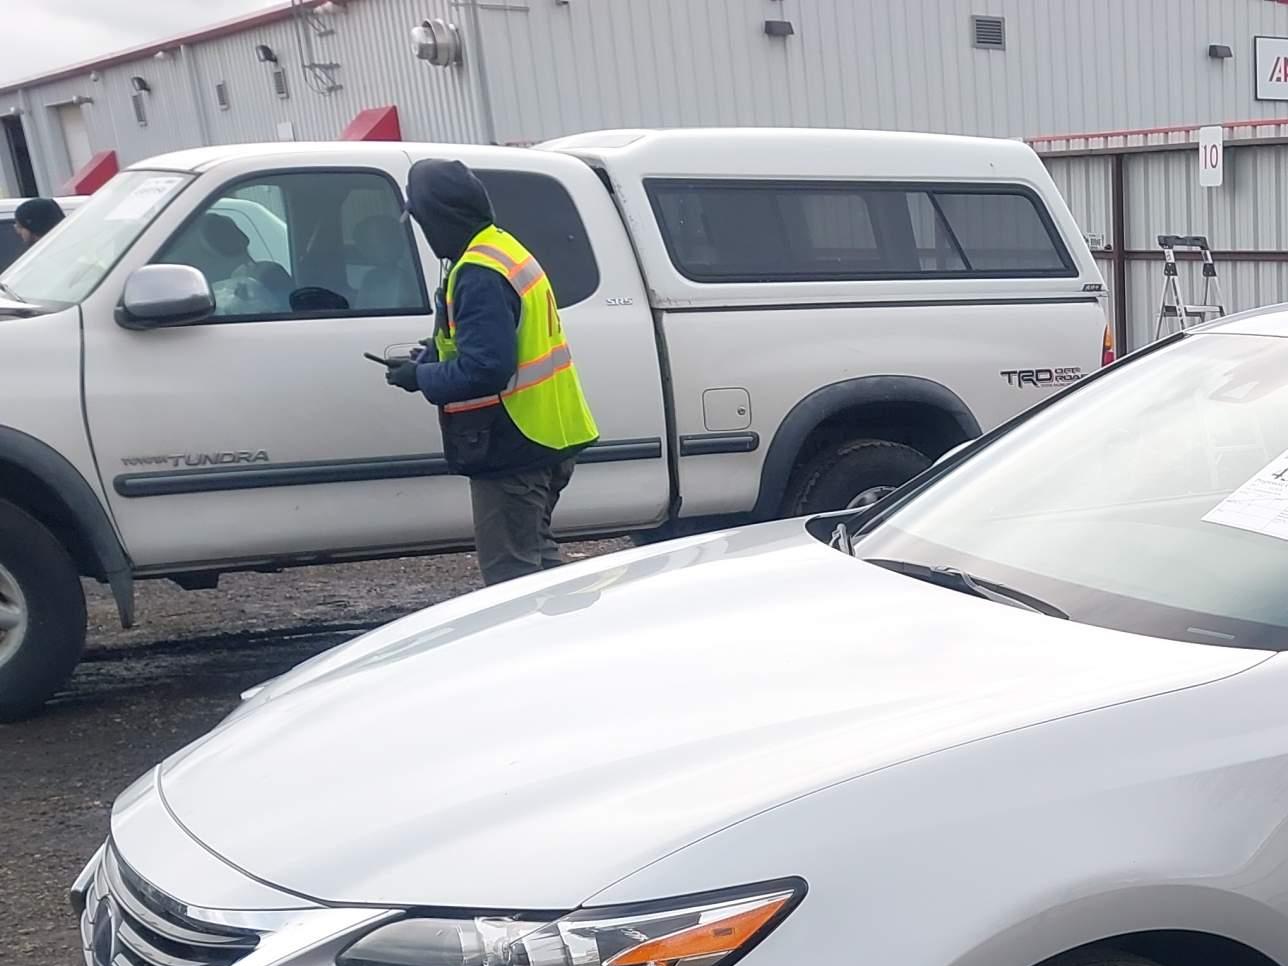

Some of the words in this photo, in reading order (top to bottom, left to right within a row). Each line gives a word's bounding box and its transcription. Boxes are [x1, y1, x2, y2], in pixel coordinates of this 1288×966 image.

[1201, 144, 1218, 169] 10
[1000, 369, 1053, 388] TRD
[168, 450, 269, 467] TUNDRA
